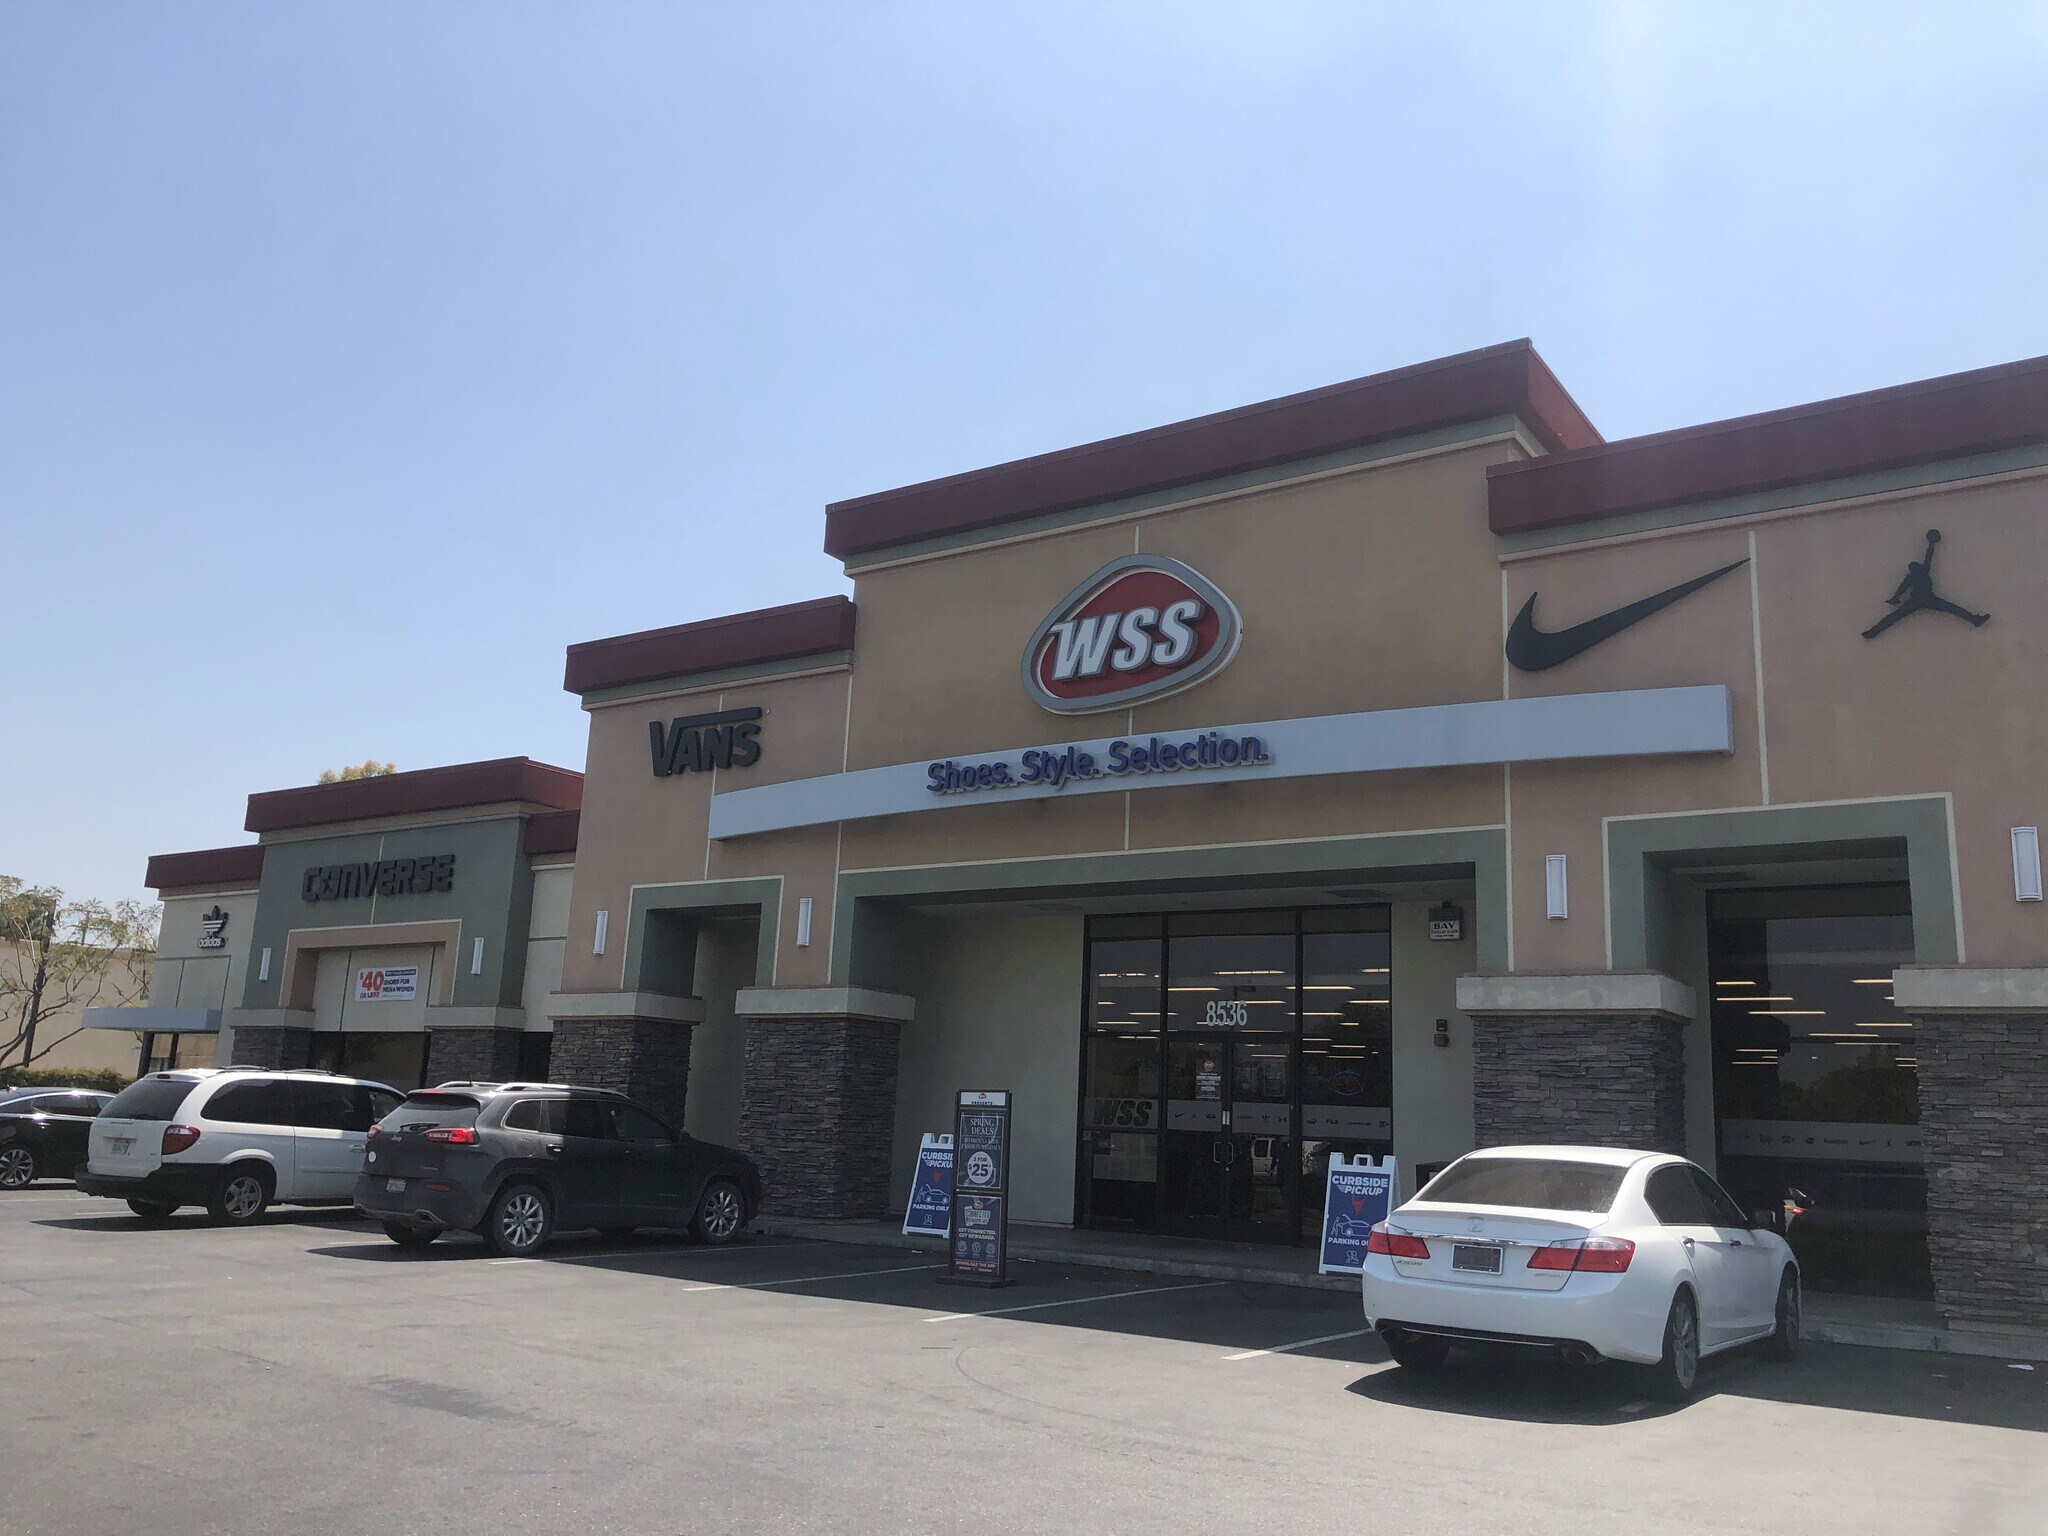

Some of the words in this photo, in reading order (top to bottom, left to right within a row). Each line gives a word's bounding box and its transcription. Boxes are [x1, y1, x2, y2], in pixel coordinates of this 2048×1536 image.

[1047, 598, 1204, 681] WSS
[649, 707, 762, 777] VANS
[926, 759, 1010, 794] Shoes.
[1020, 745, 1099, 789] Style.
[1107, 731, 1269, 774] Selection.
[302, 854, 456, 902] CONVERSE
[1433, 922, 1455, 930] BAY
[198, 937, 222, 948] adidas
[360, 971, 385, 991] $40
[1206, 1000, 1247, 1026] 8536
[1093, 1100, 1153, 1127] WSS
[970, 1118, 995, 1127] SPRING
[971, 1126, 994, 1135] DEALS
[930, 1160, 953, 1168] PICKU
[1332, 1175, 1389, 1188] CURBSIDE
[1345, 1185, 1383, 1196] PICKUP
[912, 1203, 936, 1211] PARKING
[1328, 1237, 1360, 1247] PARKING
